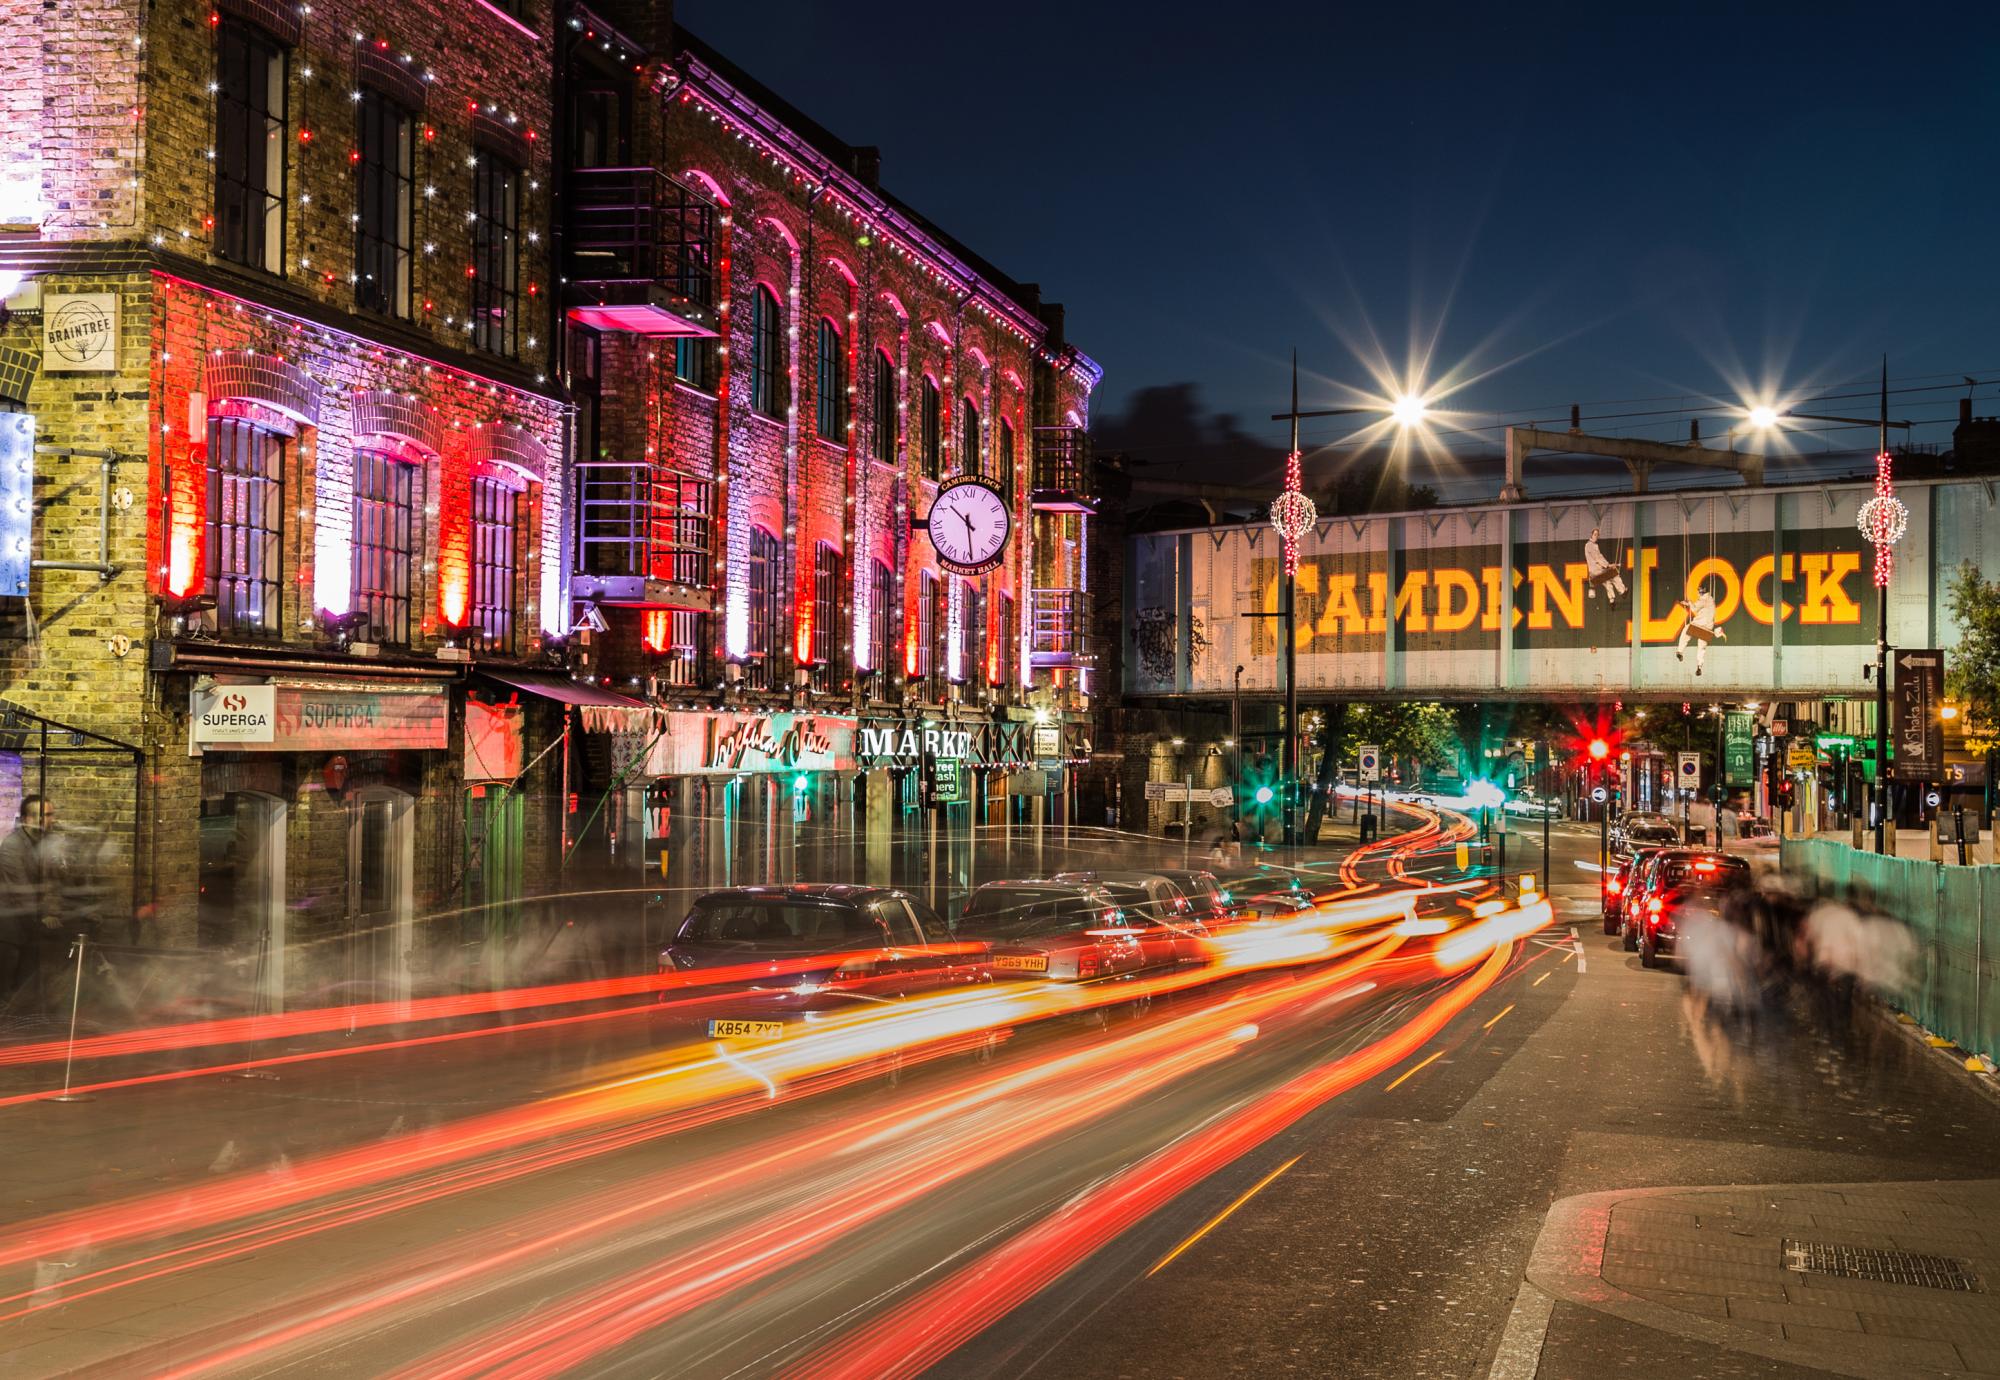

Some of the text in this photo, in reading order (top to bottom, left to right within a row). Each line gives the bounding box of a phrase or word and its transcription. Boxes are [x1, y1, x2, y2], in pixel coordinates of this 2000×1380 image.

[48, 318, 111, 344] BRAINTREE
[941, 475, 1002, 491] CAMDEN LOCK
[940, 559, 1000, 575] MARKET HALL
[1262, 560, 1589, 650] CAMDEN
[1626, 546, 1861, 643] LOCK
[304, 703, 374, 729] SUPERGA
[1904, 675, 1921, 741] Shaka Zulu
[203, 714, 267, 726] SUPERGA
[936, 763, 954, 772] ree
[1023, 958, 1044, 969] YHH
[717, 1022, 751, 1035] KB54
